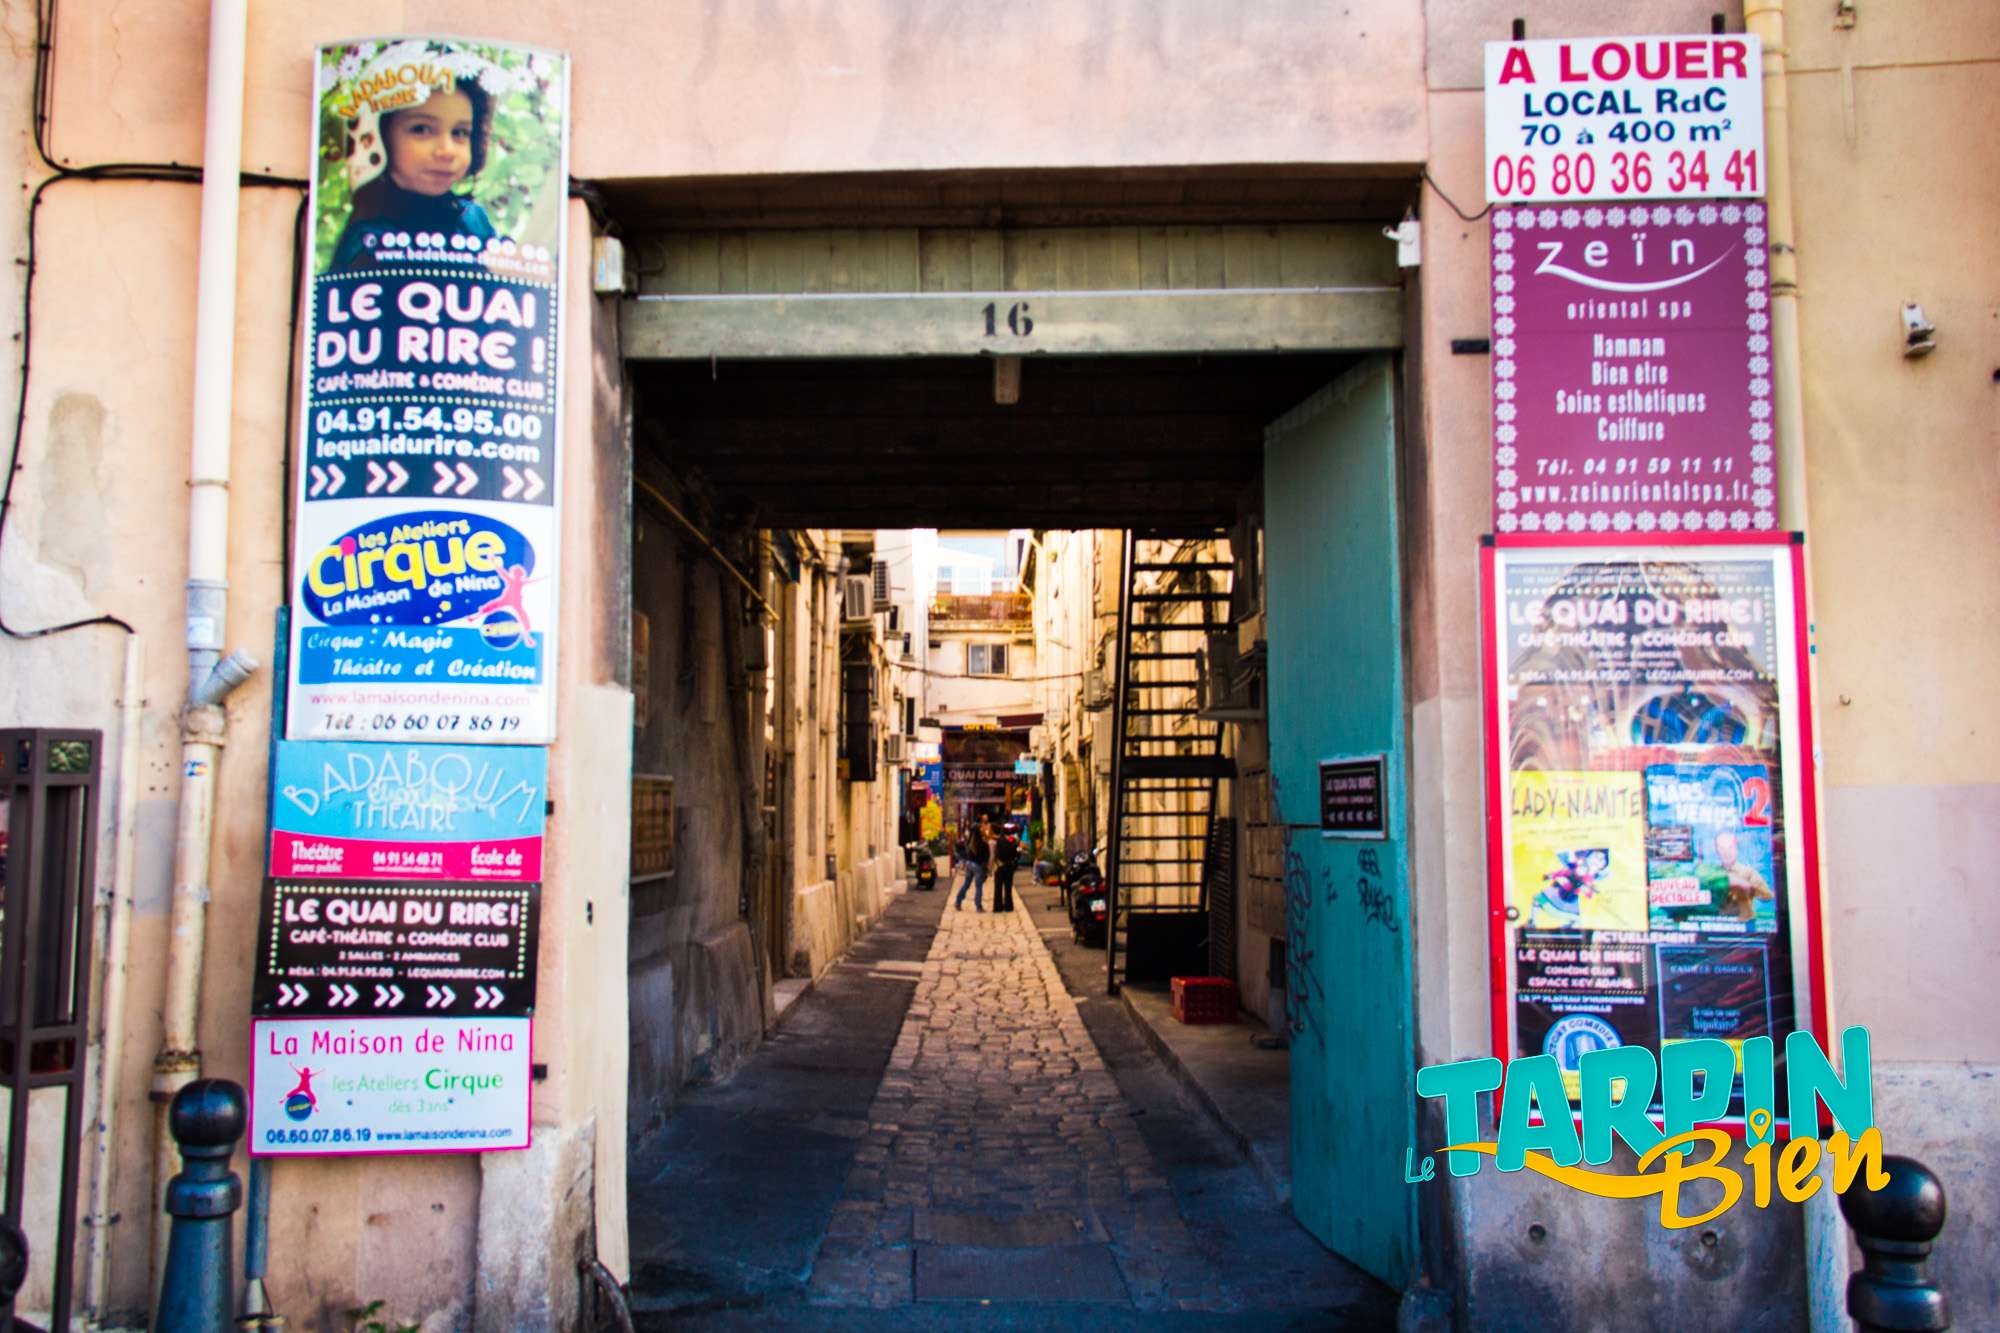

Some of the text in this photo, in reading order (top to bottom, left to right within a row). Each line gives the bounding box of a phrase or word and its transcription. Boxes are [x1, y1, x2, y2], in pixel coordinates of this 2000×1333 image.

[1498, 40, 1748, 86] A LOUER
[1523, 86, 1727, 118] LOCAL RdC
[1520, 123, 1562, 147] 70
[1576, 128, 1595, 145] à
[1608, 119, 1676, 143] 400
[1493, 149, 1759, 197] 06 80 36 34 41
[1534, 232, 1697, 275] zeïn
[328, 281, 537, 329] LE QUAI
[981, 302, 1033, 336] 16
[1567, 298, 1692, 320] oriental spa
[316, 328, 382, 367] DU
[397, 326, 517, 370] RIRE
[1593, 333, 1666, 358] Hammam
[1591, 361, 1629, 386] Bien
[506, 378, 545, 400] CLUB
[1555, 389, 1602, 414] Soins
[315, 405, 542, 440] 04.91.54.95.00
[1597, 416, 1665, 442] Coiffure
[315, 433, 541, 463] lequaidurire.com
[390, 519, 471, 543] Ateliers
[307, 530, 507, 598] Cirque
[322, 575, 502, 617] La Maison de Nina
[1509, 599, 1545, 625] LE
[1551, 598, 1629, 627] QUAI
[1634, 599, 1679, 625] DU
[307, 632, 364, 652] Cirque
[382, 630, 453, 654] Magie
[414, 659, 433, 676] et
[447, 657, 537, 680] Création
[372, 713, 396, 731] 06
[403, 713, 429, 731] 60
[436, 713, 459, 731] 07
[468, 713, 493, 731] 86
[500, 713, 521, 731] 19
[282, 749, 537, 824] BADABOUM
[977, 769, 993, 779] DU
[1511, 785, 1641, 818] LADY-NAMITE
[1743, 777, 1772, 827] 2
[291, 840, 344, 861] Théâtre
[470, 845, 523, 866] École de
[284, 899, 320, 923] LE
[326, 899, 398, 926] QUAI
[403, 901, 444, 925] DU
[473, 932, 510, 947] CLUB
[1518, 949, 1536, 962] LE
[1539, 949, 1577, 962] QUAI
[1579, 950, 1601, 963] DU
[1528, 977, 1569, 987] ESPACE
[269, 1027, 514, 1055] La Maison de Nina
[333, 1068, 504, 1096] les Ateliers Cirque
